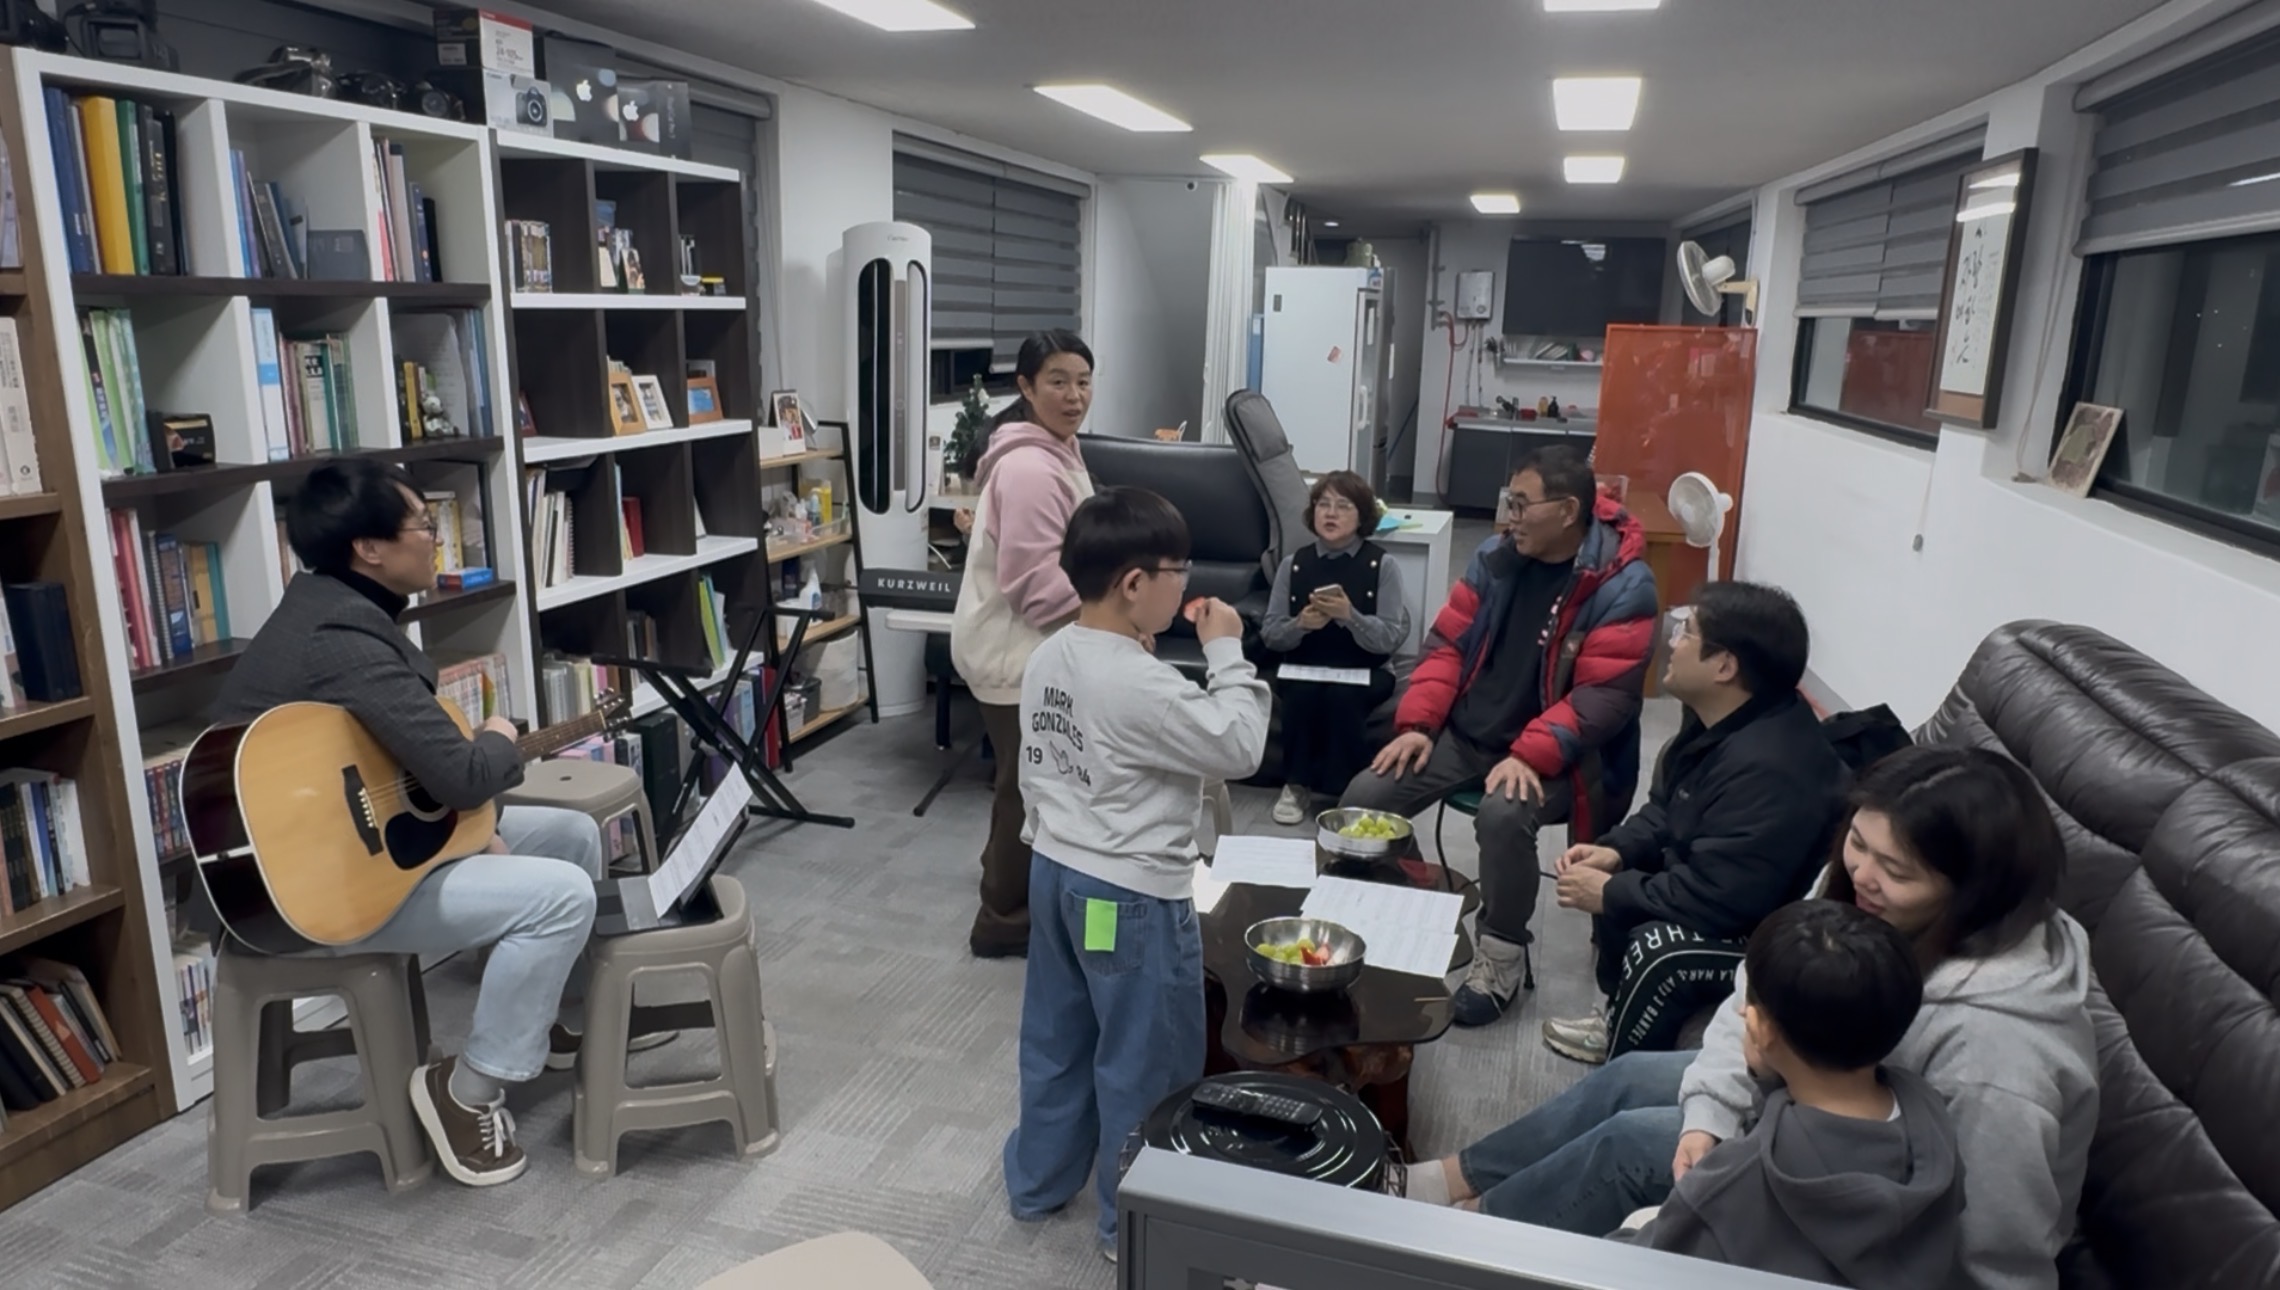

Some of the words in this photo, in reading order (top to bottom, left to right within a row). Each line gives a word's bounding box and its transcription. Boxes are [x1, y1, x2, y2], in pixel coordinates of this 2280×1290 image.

[877, 577, 951, 593] KURZWEIL
[1043, 686, 1074, 718] MARK
[1025, 745, 1044, 765] 19
[1622, 924, 1704, 980] THREE
